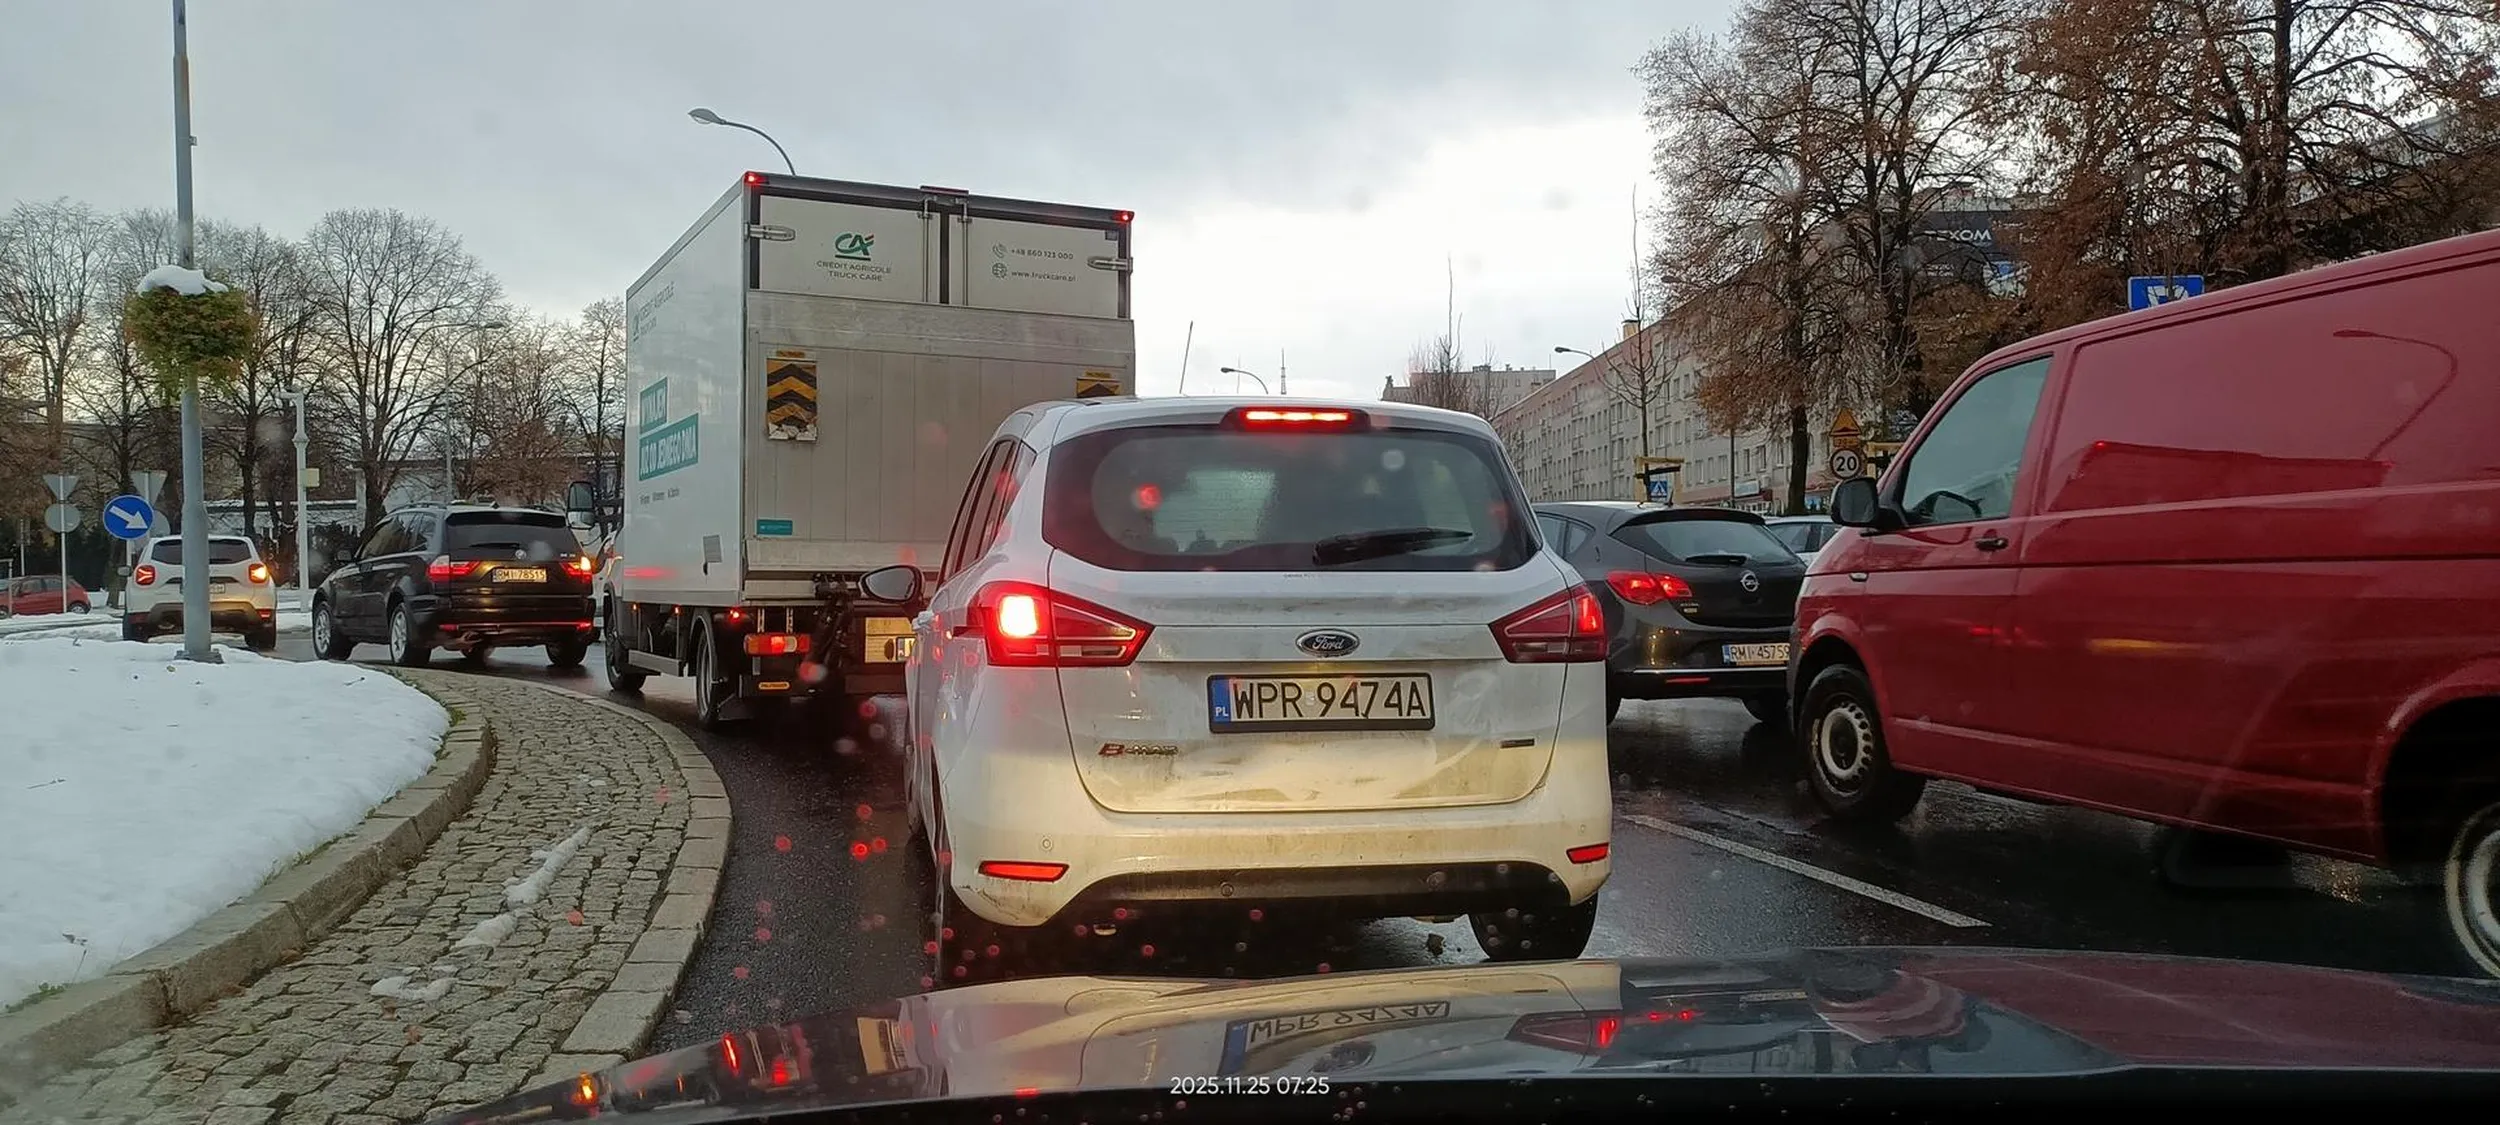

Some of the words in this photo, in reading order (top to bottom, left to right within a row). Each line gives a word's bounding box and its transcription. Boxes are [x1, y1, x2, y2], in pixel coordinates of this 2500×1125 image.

[1058, 251, 1074, 260] 000
[849, 264, 892, 274] AGRICOLE
[829, 270, 858, 280] TRUCK
[859, 273, 883, 282] CARE
[1835, 456, 1857, 471] 20
[1312, 635, 1345, 650] Ford
[1731, 646, 1752, 660] RMI
[1233, 682, 1304, 719] WPR
[1316, 681, 1427, 719] 9474A
[1215, 706, 1229, 718] PL
